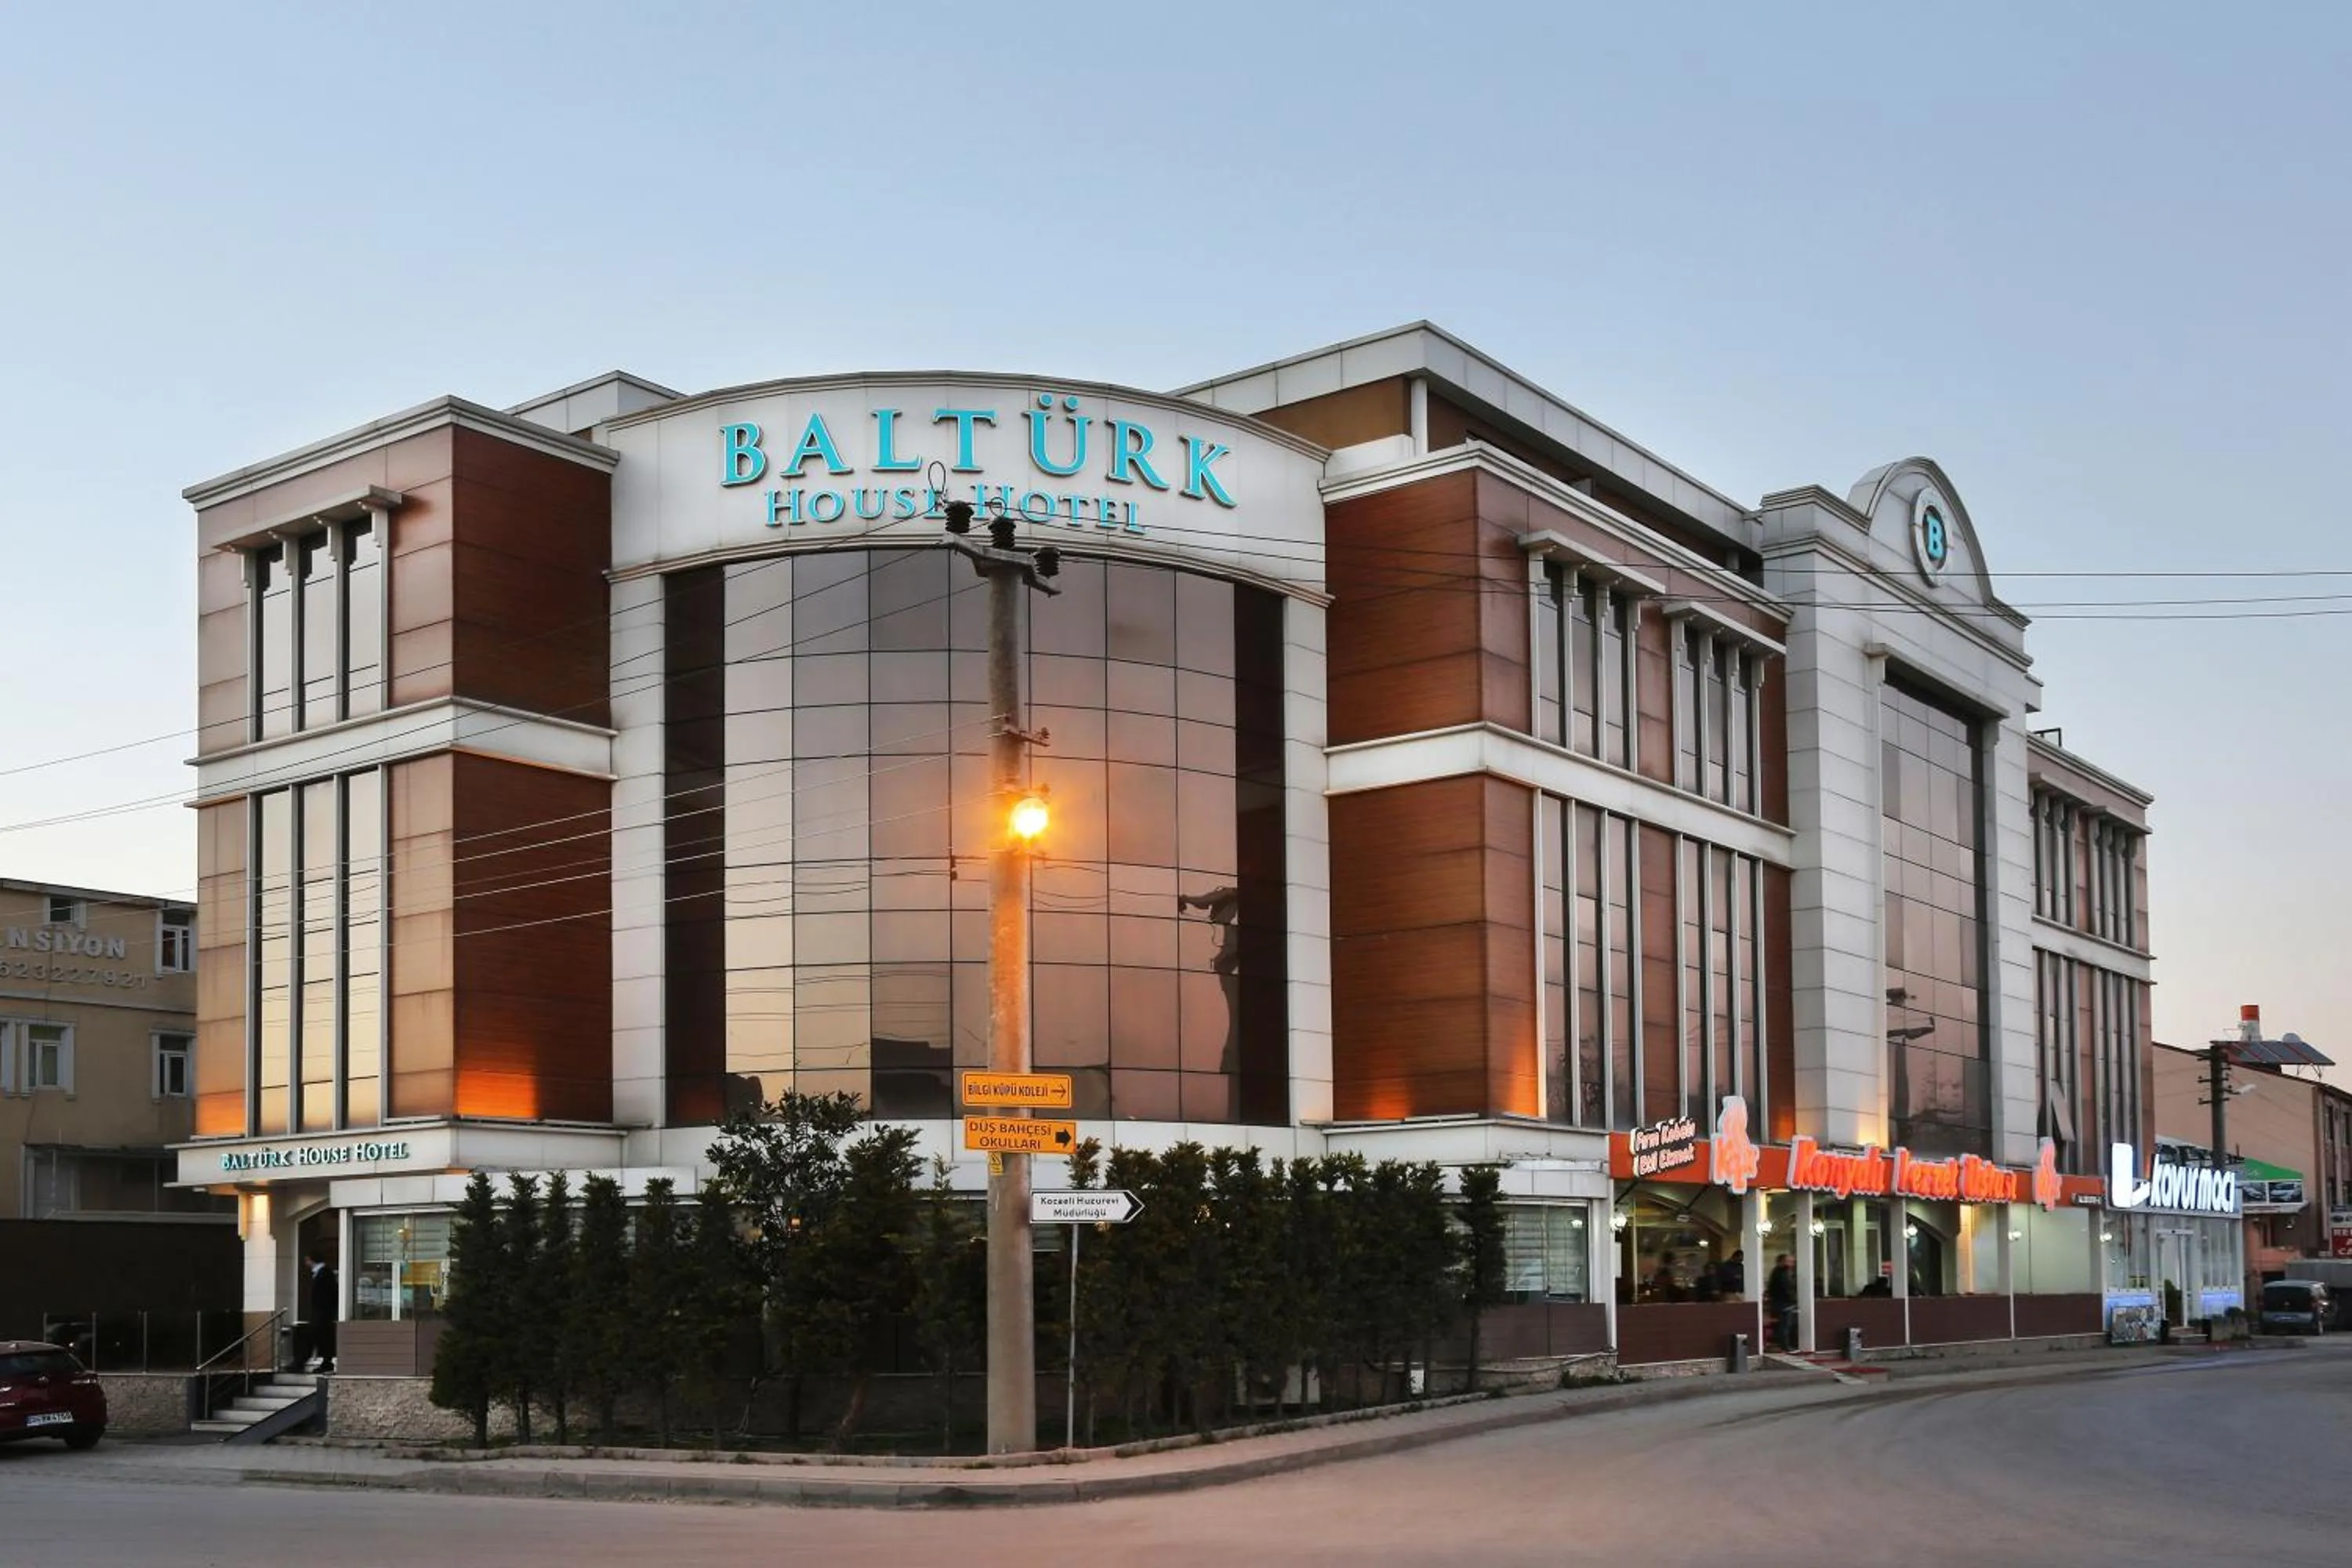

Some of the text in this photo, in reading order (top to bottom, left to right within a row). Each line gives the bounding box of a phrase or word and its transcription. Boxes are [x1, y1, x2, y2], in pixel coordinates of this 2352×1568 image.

[718, 394, 1237, 508] BALTÜRK
[764, 482, 1147, 534] HOUSE HOTEL
[1926, 513, 1944, 559] B
[0, 925, 126, 960] NSİYON
[967, 1081, 992, 1095] BİLGİ
[1018, 1083, 1048, 1097] KOLEJİ
[969, 1120, 1052, 1137] DÜŞ BAHÇESİ
[979, 1136, 1041, 1149] OKULLARI
[221, 1142, 407, 1171] BALTÜRK HOUSE HOTEL
[1040, 1196, 1119, 1205] Kocaeli Huzurevi
[1054, 1208, 1106, 1218] Müdürlüğü
